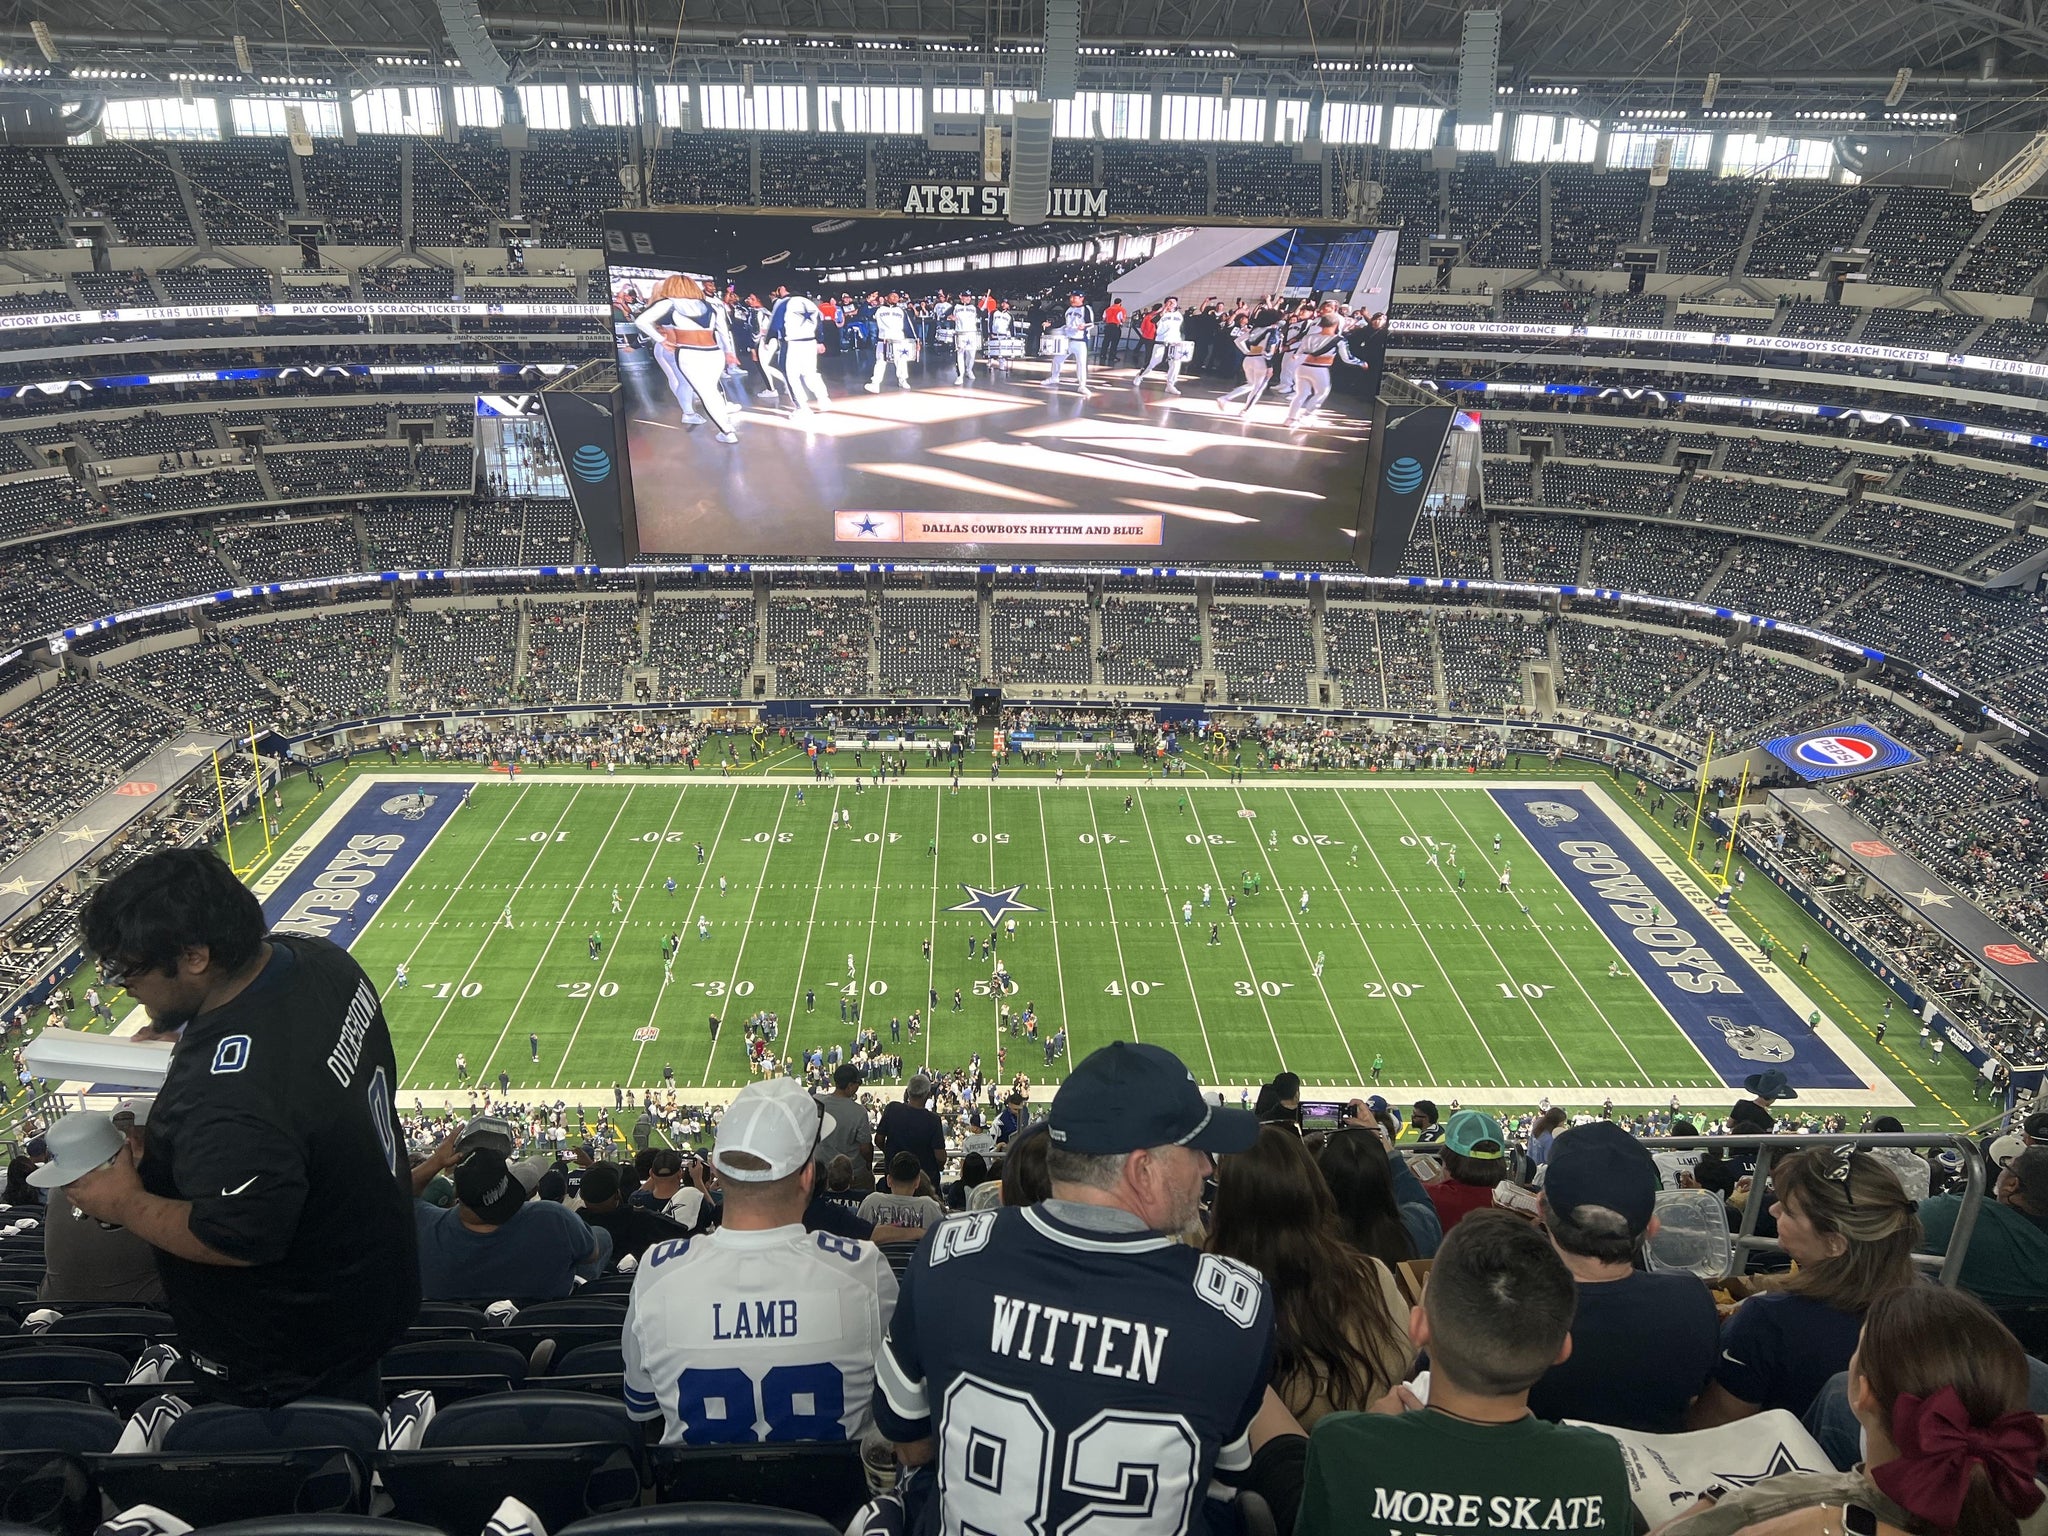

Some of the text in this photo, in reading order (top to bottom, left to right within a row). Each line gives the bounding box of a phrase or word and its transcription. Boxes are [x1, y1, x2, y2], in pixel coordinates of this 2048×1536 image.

[904, 185, 1108, 217] AT&T STIUM
[44, 313, 82, 324] DANCE
[145, 307, 230, 318] TEXAS LOTTERY
[293, 305, 471, 314] PLAY COWBOYS SCRATCH TICKETS!
[526, 305, 600, 314] TEXAS LOTTERY
[1432, 322, 1447, 331] ON
[1450, 323, 1475, 332] YOUR
[1479, 324, 1520, 333] VICTORY
[1523, 325, 1556, 334] DANCE
[1611, 328, 1688, 341] TEXAS LOTTERY
[1746, 337, 1929, 361] PLAY COWBOYS SCRATCH TICKETS!
[1988, 359, 2023, 373] TEXAS
[922, 523, 1143, 535] DALLAS COWBOYS RHYTHM AND BLUE
[1102, 568, 1120, 576] Cowboys
[1320, 574, 1336, 582] Official
[1344, 575, 1360, 583] Partner
[1390, 577, 1409, 585] Cowboys
[280, 583, 298, 591] Official
[308, 580, 326, 588] Partner
[342, 577, 357, 585] Dallas
[359, 574, 381, 584] Cowboys
[1922, 672, 1960, 699] Blockchain.com
[1987, 708, 2030, 738] Blockchain.com
[1815, 739, 1858, 764] PEPSI
[260, 845, 311, 886] CLEATS
[1558, 841, 1744, 994] COWBOYS
[1651, 855, 1668, 866] IT
[1670, 867, 1709, 906] TAKES
[1729, 936, 1756, 954] OF
[1750, 957, 1778, 974] US
[431, 981, 483, 999] 10
[567, 981, 620, 999] 20
[704, 980, 755, 998] 30
[839, 979, 888, 996] 40
[971, 979, 1020, 997] 50
[1103, 979, 1150, 997] 40
[1233, 980, 1281, 997] 30
[1363, 981, 1412, 998] 20
[1496, 982, 1546, 1000] 10
[326, 978, 378, 1088] OVERSHOWN
[1677, 1156, 1699, 1166] LAMB
[871, 1204, 924, 1228] VENOM
[712, 1299, 798, 1340] LAMB
[990, 1294, 1169, 1385] WITTEN
[677, 1361, 847, 1444] 88
[937, 1370, 1201, 1536] 82
[1371, 1487, 1605, 1531] MORE SKATE,
